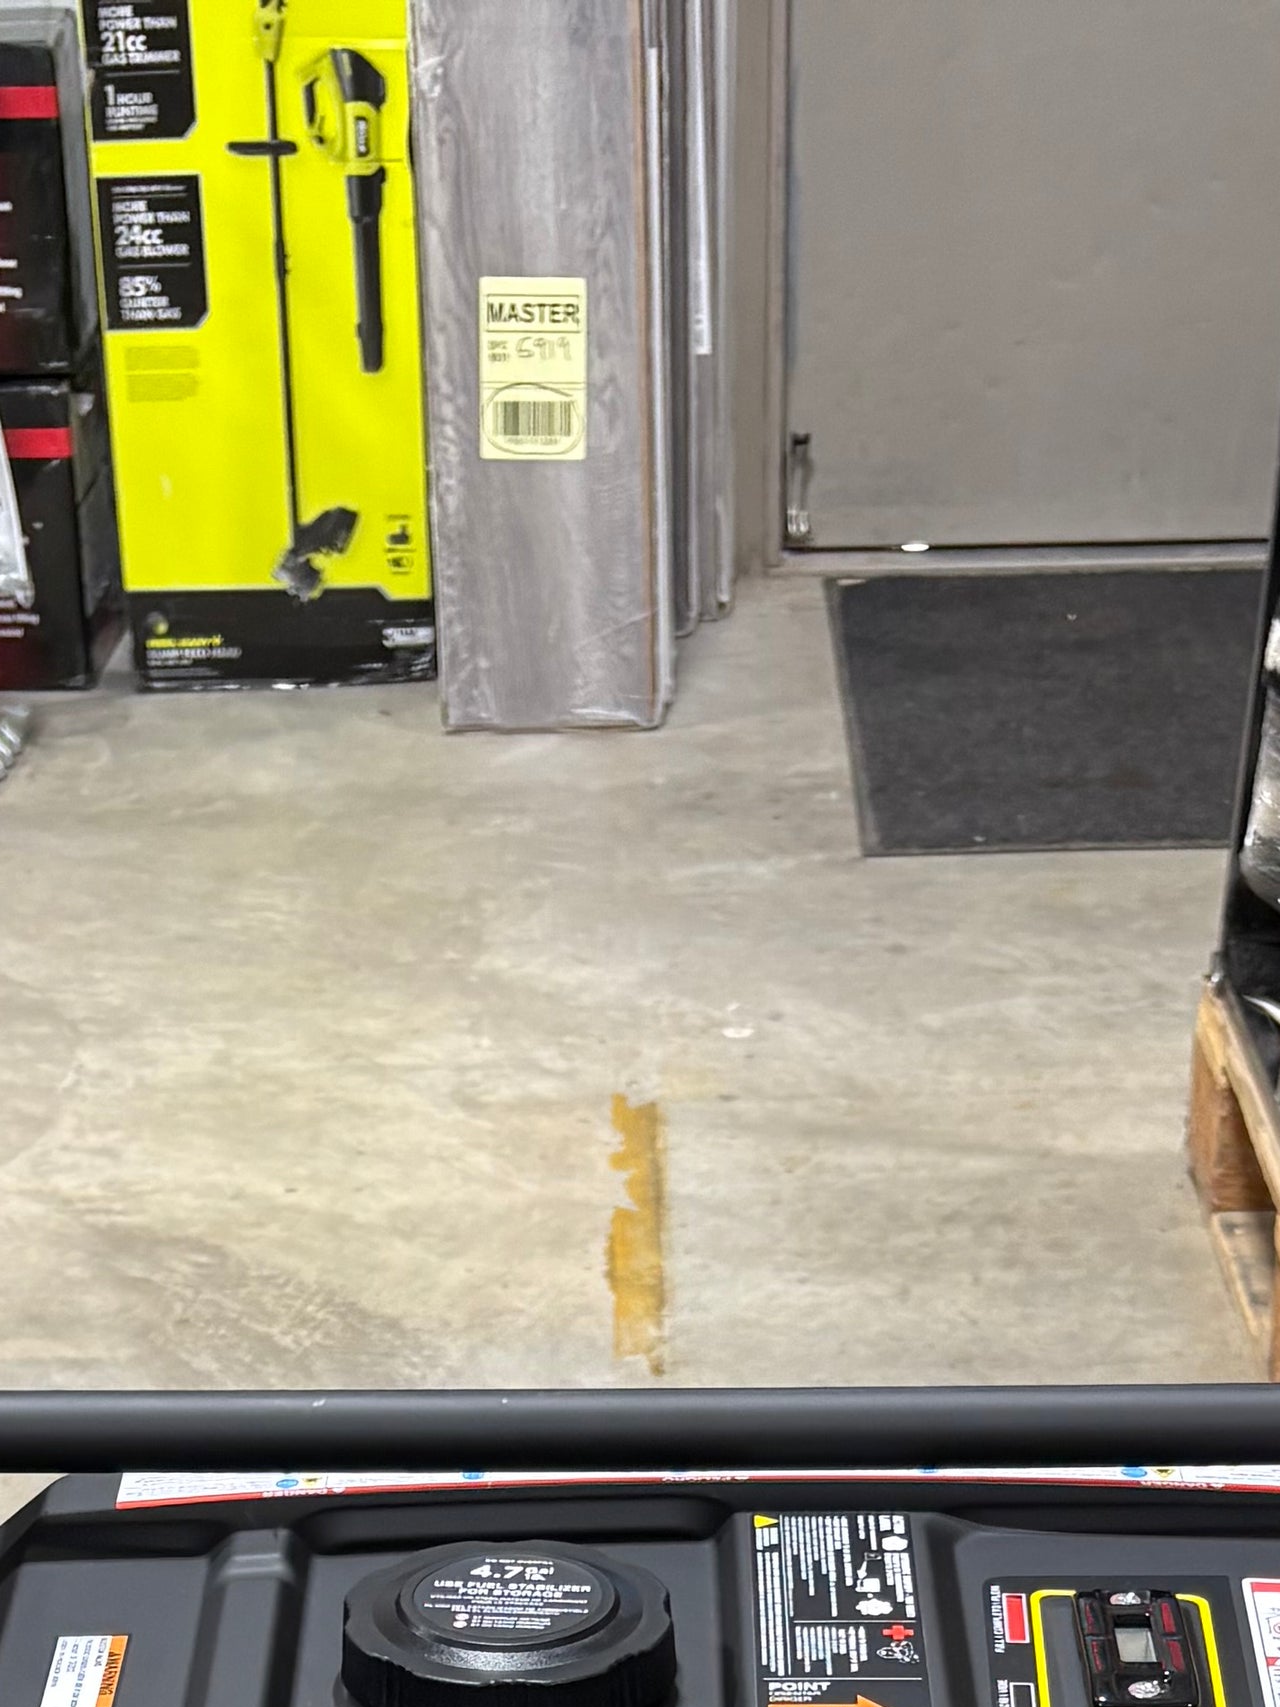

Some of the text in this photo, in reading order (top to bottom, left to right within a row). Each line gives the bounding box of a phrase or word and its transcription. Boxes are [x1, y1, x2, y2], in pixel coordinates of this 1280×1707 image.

[100, 31, 148, 53] 21cc
[114, 225, 163, 245] 24cc
[487, 301, 580, 325] MASTER
[469, 1564, 524, 1579] 4.7
[433, 1580, 591, 1592] USE FUEL STABILIZER
[492, 1589, 563, 1598] STORAGE
[768, 1682, 830, 1692] POINT
